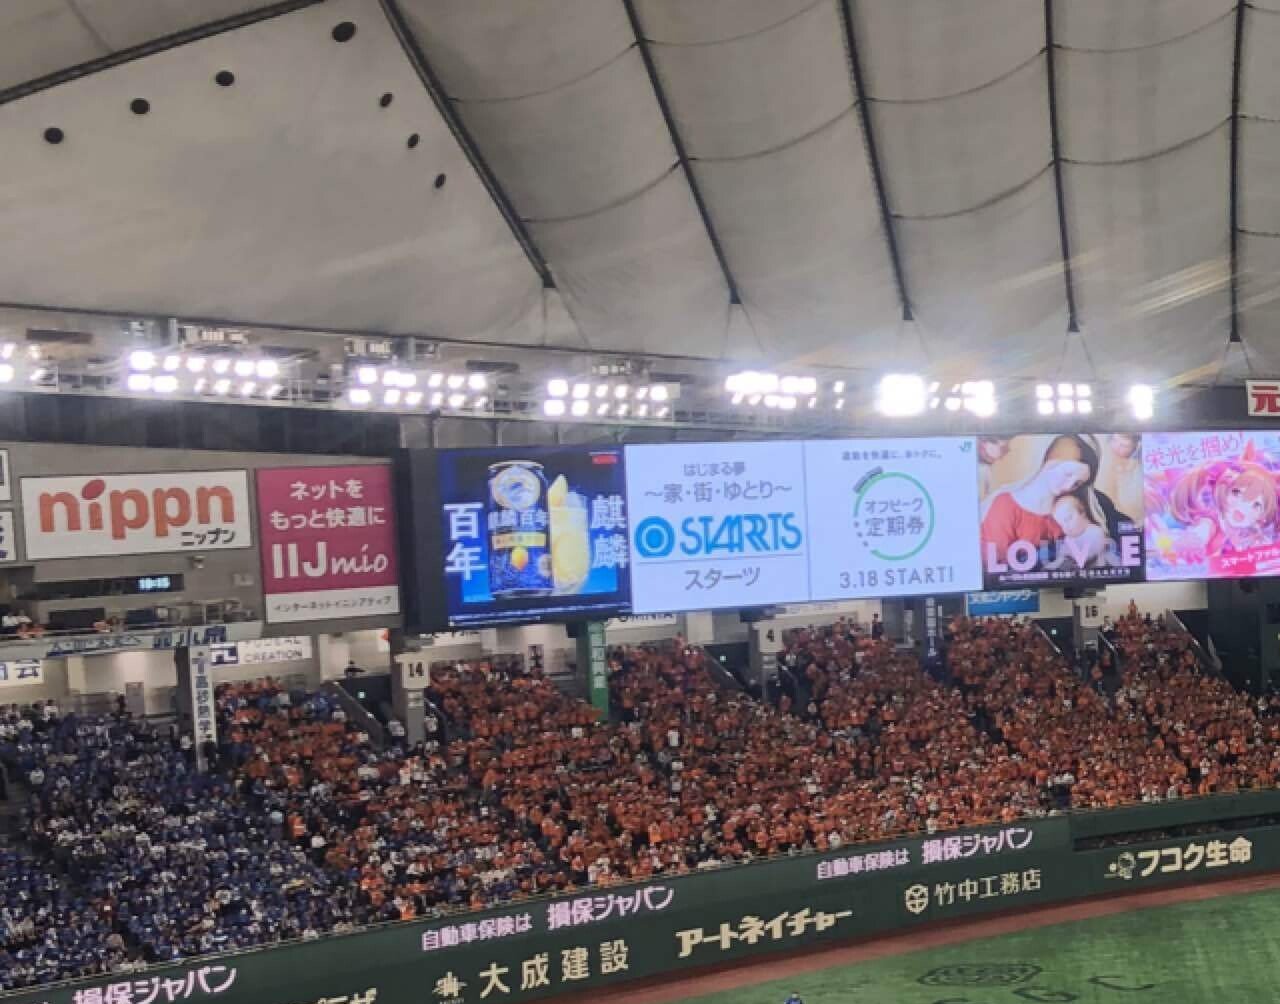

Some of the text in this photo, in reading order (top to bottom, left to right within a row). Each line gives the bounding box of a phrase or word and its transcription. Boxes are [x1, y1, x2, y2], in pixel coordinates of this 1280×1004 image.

[683, 462, 746, 477] はじまる夢
[290, 480, 363, 501] ネットを
[865, 498, 923, 512] オフピーク
[40, 480, 235, 540] nippn
[270, 506, 385, 530] もっと快適に
[865, 515, 924, 536] 定期券
[180, 528, 235, 546] ニップン
[444, 502, 484, 580] 百年
[680, 513, 801, 552] STARTS
[685, 568, 759, 589] スターツ
[840, 566, 953, 588] 3.18 START!
[408, 662, 424, 678] 14
[817, 826, 1033, 880] 自動車保険は 損保ジャパン
[1136, 837, 1252, 878] フコク生命
[934, 868, 1041, 906] 竹中工務店
[422, 885, 674, 951] 自動車保険は 損保ジャパン
[675, 906, 853, 959] アートネイチャー
[479, 938, 630, 999] 大成建設
